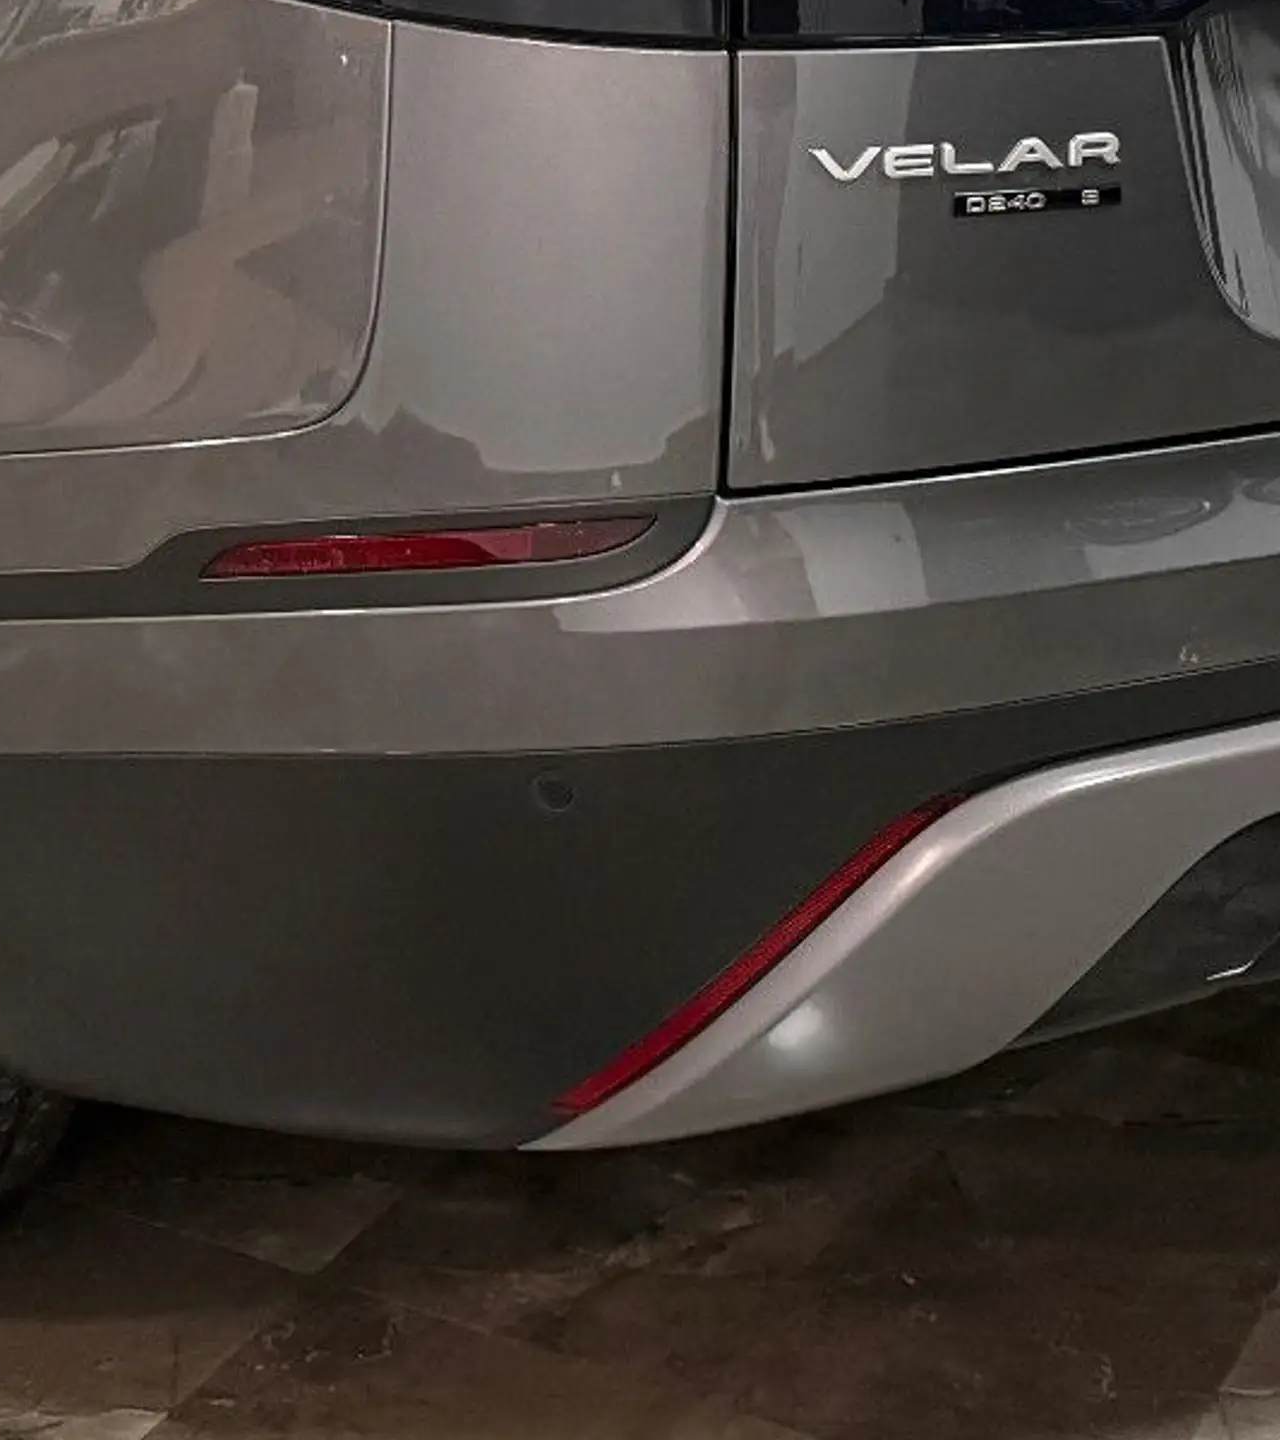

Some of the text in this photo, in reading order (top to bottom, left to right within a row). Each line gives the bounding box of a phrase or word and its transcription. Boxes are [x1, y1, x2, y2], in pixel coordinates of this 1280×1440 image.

[807, 131, 1121, 181] VELAR
[966, 188, 1100, 214] D240 S
